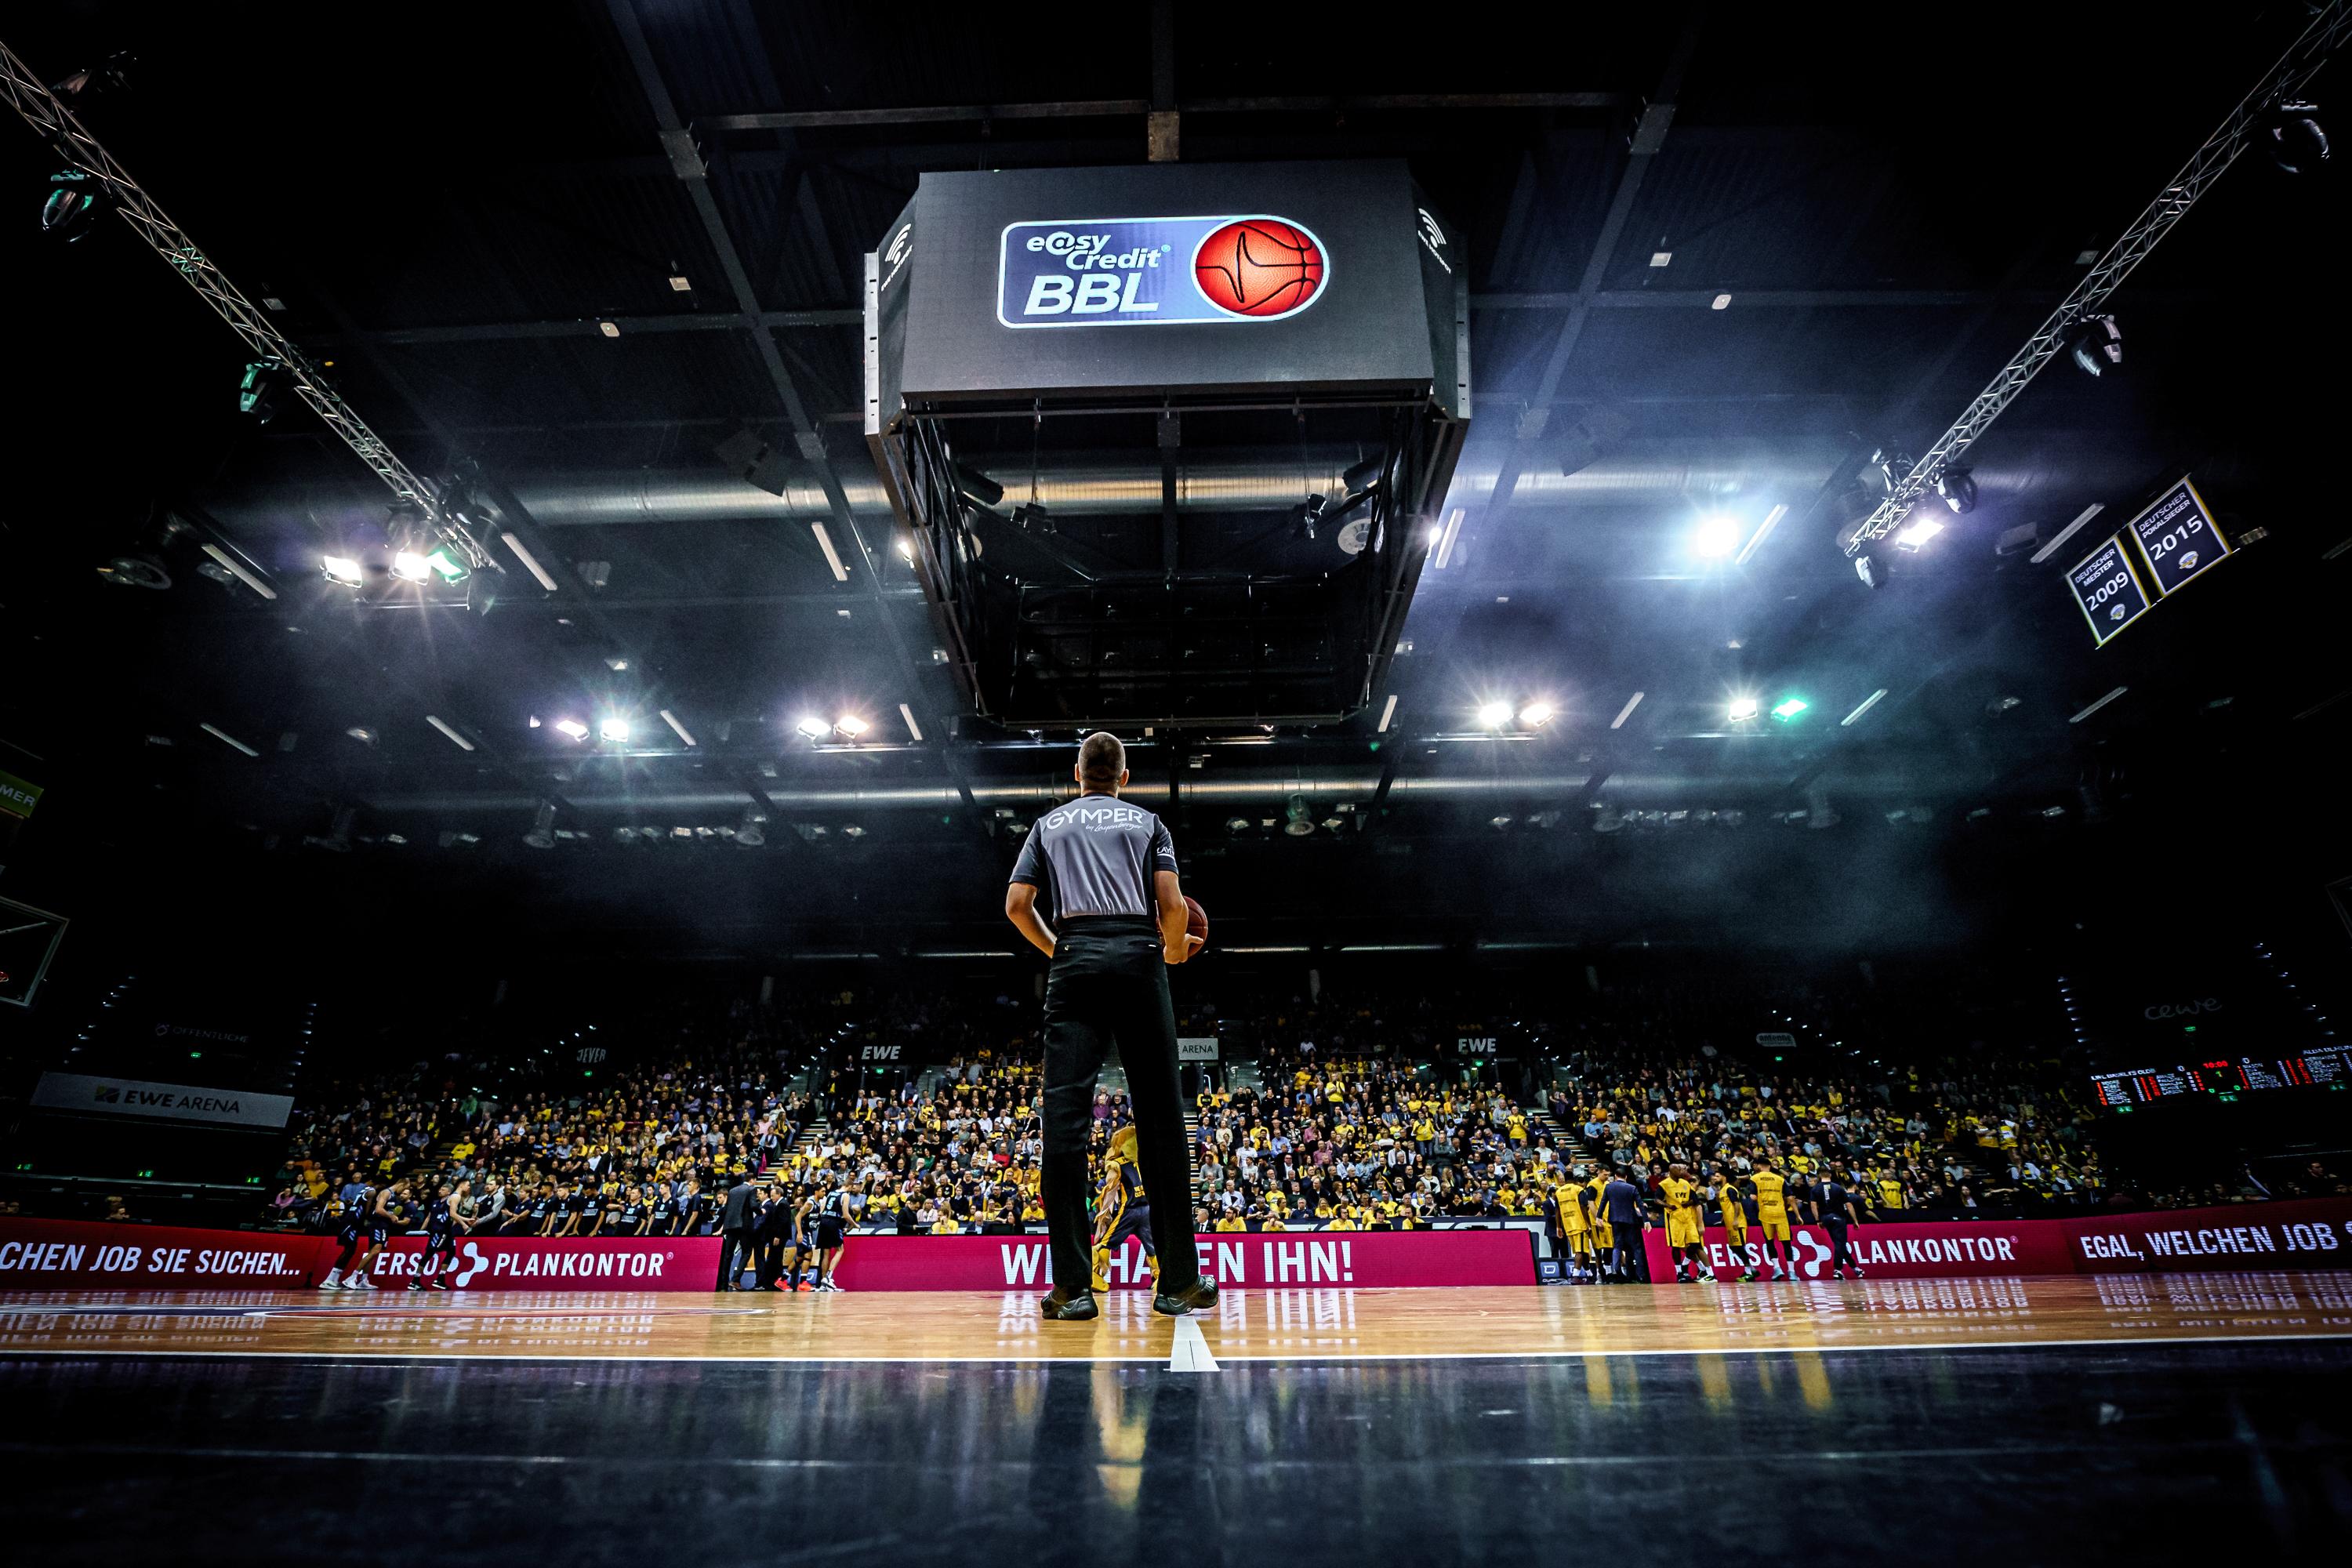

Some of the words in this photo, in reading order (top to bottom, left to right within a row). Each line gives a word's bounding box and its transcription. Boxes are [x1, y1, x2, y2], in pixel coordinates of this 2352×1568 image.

[1023, 272, 1160, 315] BBL
[2139, 492, 2187, 532] DEUTSCHER
[2142, 499, 2190, 539] POKALSIEGER
[2150, 514, 2203, 561] 2015
[2074, 548, 2115, 583] DEUTSCHER
[2083, 560, 2114, 586] MEISTER
[2085, 572, 2129, 612] 2009
[1046, 808, 1142, 829] GYMPER
[577, 1047, 607, 1064] JEVER
[861, 1045, 902, 1060] EWE
[1182, 1044, 1214, 1054] ARENA
[1458, 1037, 1497, 1052] EWE
[124, 1090, 174, 1107] EWE
[176, 1096, 240, 1113] ARENA
[2080, 1234, 2145, 1261] EGAL,
[2145, 1225, 2277, 1256] WELCHEN
[2281, 1222, 2339, 1251] JOB
[0, 1242, 86, 1271] CHEN
[89, 1246, 143, 1272] JOB
[147, 1248, 191, 1273] SIE
[194, 1250, 301, 1276] SUCHEN...
[1000, 1243, 1054, 1284] WI
[1104, 1242, 1245, 1283] HAEN
[1263, 1241, 1354, 1283] IHN!
